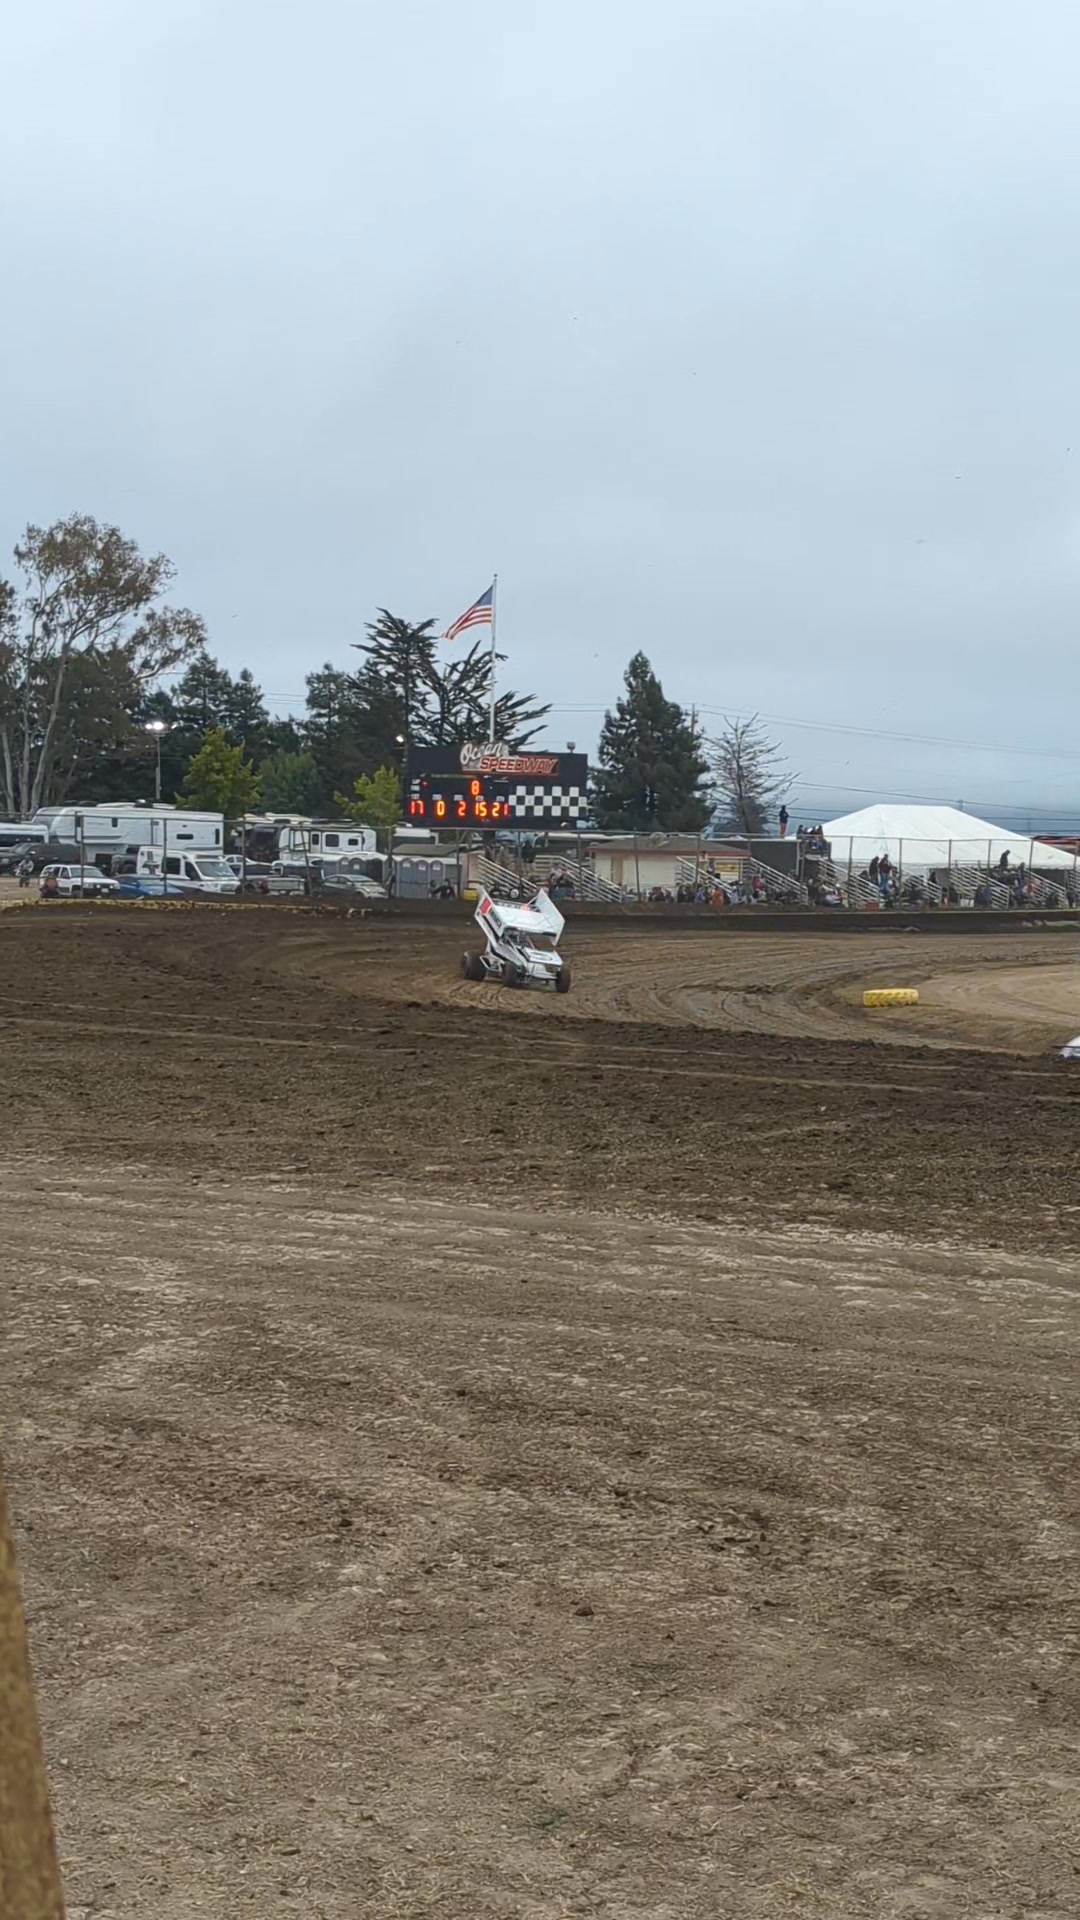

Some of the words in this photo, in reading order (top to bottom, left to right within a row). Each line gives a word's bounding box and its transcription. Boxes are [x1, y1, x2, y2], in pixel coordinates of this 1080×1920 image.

[460, 741, 502, 765] Ocean
[479, 756, 557, 774] SPEEDWAY
[471, 780, 480, 795] 8
[410, 800, 424, 815] 17
[437, 800, 445, 816] 0
[457, 801, 466, 816] 2
[475, 801, 487, 816] 15
